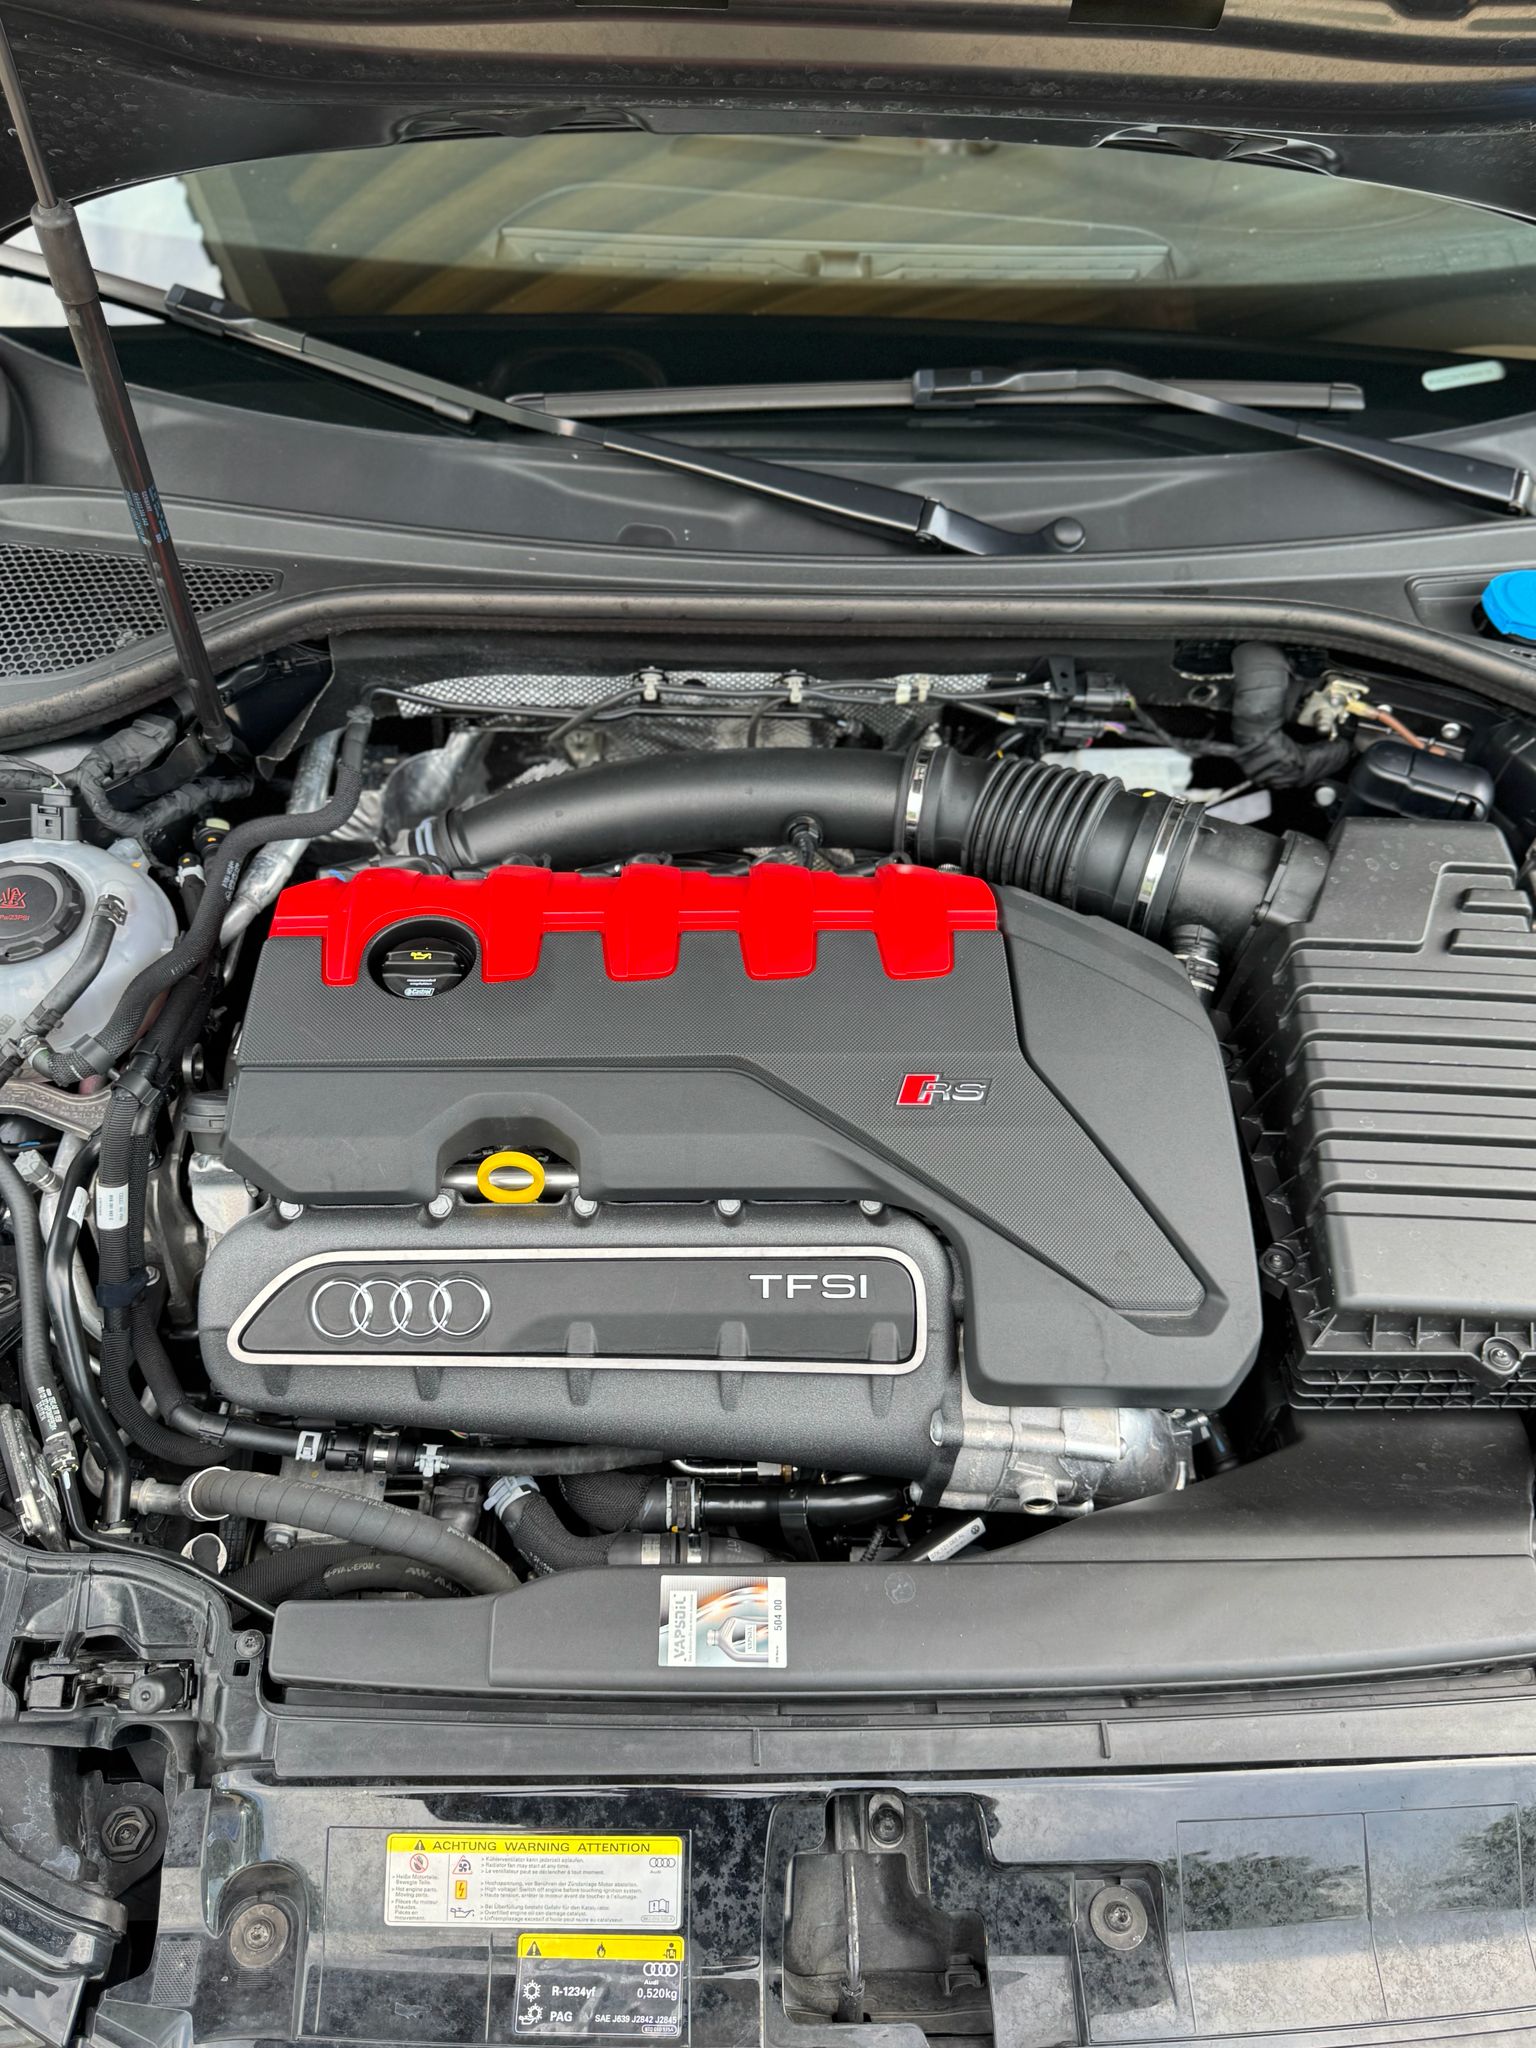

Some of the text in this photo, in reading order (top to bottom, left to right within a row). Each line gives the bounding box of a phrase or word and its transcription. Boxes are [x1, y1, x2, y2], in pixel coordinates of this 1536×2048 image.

[910, 1079, 987, 1103] RS
[749, 1274, 868, 1299] TFSI
[773, 1599, 784, 1631] 504 00
[433, 1841, 650, 1853] ACHTUNG WARNING ATTENTION
[551, 1986, 678, 2001] R-1234yf 0,520kg
[550, 2010, 677, 2025] PAG SAE J639 J2842 J2845
